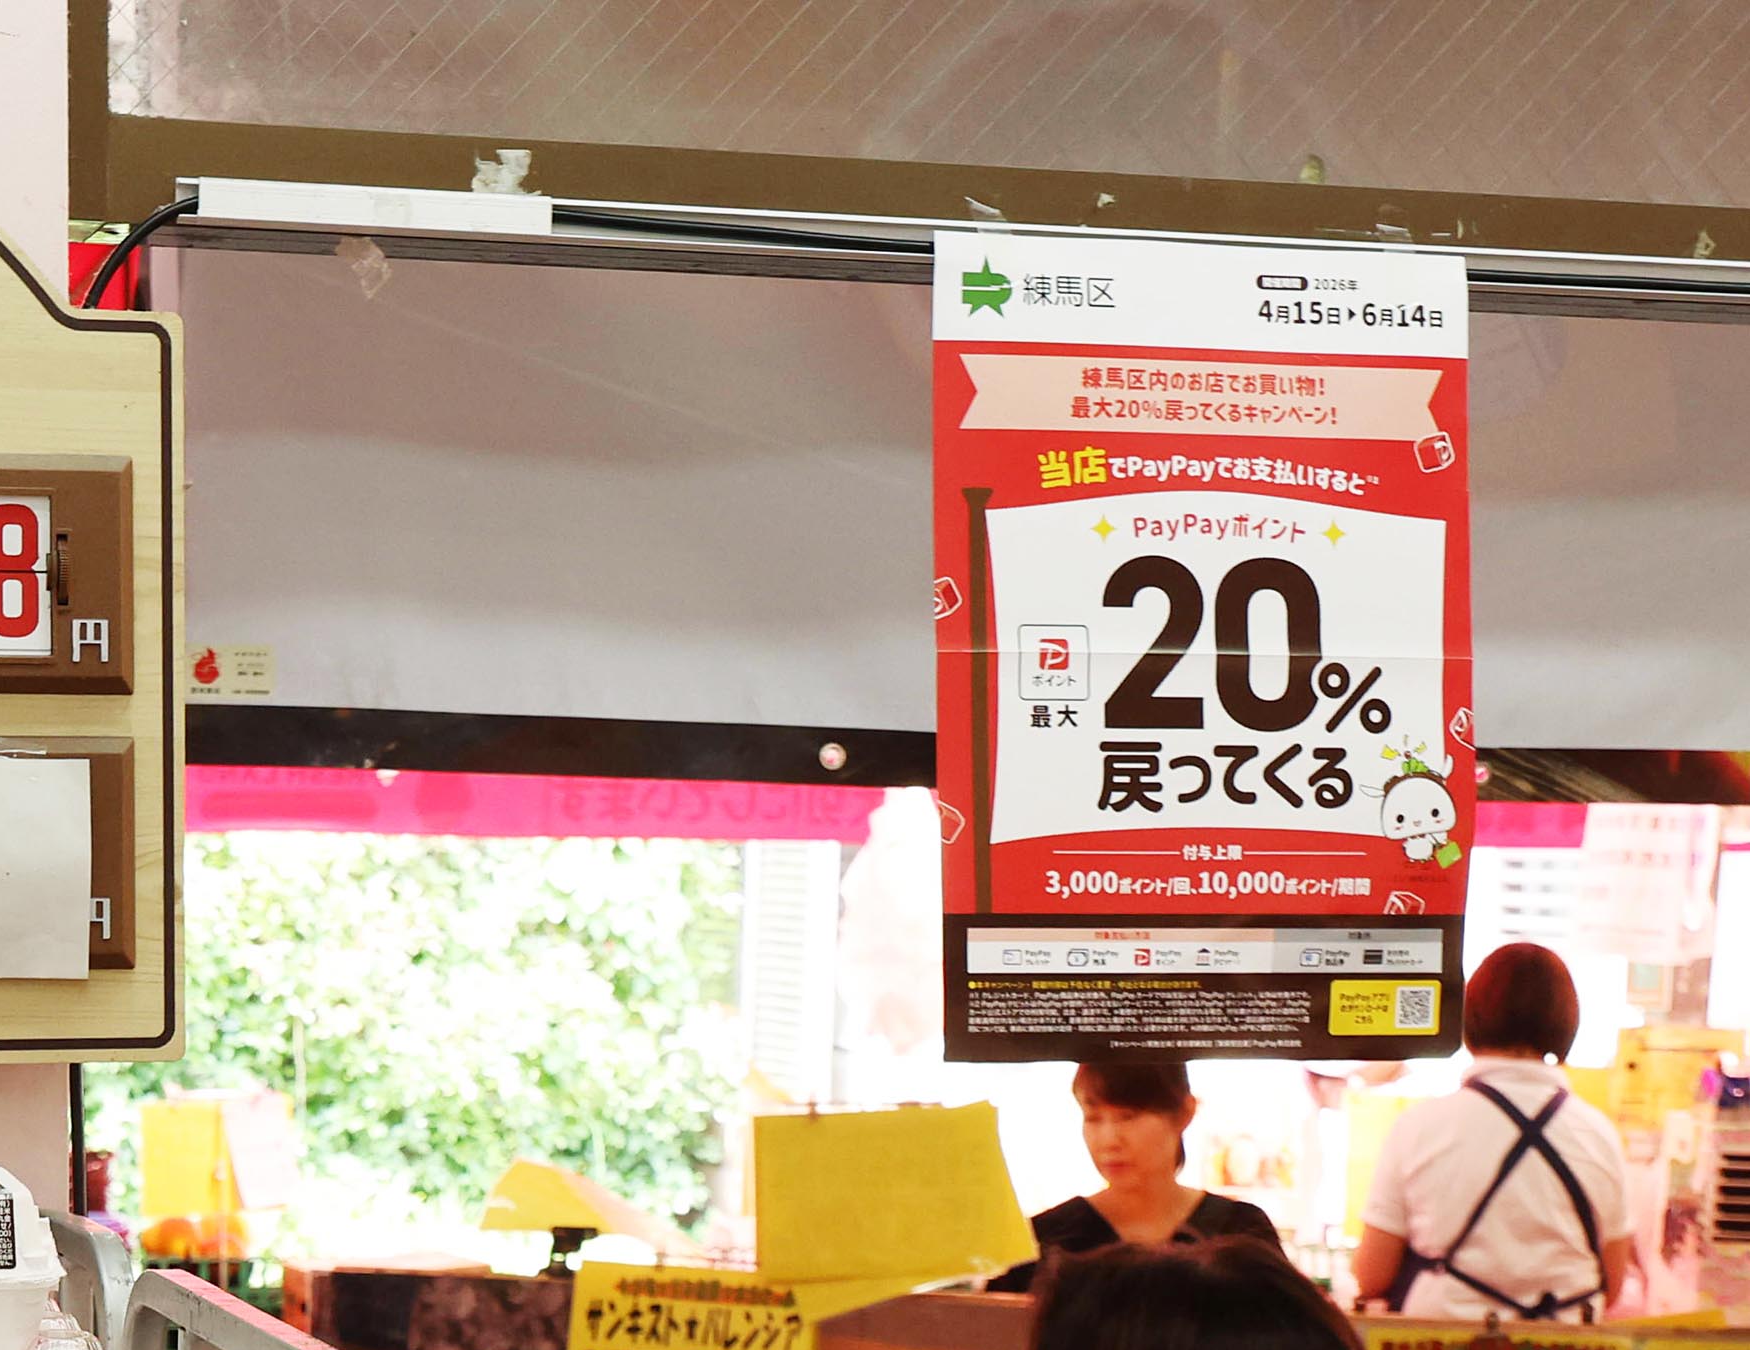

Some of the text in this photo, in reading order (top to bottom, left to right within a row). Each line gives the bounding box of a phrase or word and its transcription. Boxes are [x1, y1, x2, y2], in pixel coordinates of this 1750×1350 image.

[1023, 275, 1115, 308] 練馬区
[1133, 514, 1305, 543] PayPayポイント
[1032, 674, 1076, 687] ポイント
[1030, 705, 1078, 728] 最大
[1098, 741, 1353, 812] 戻ってくる
